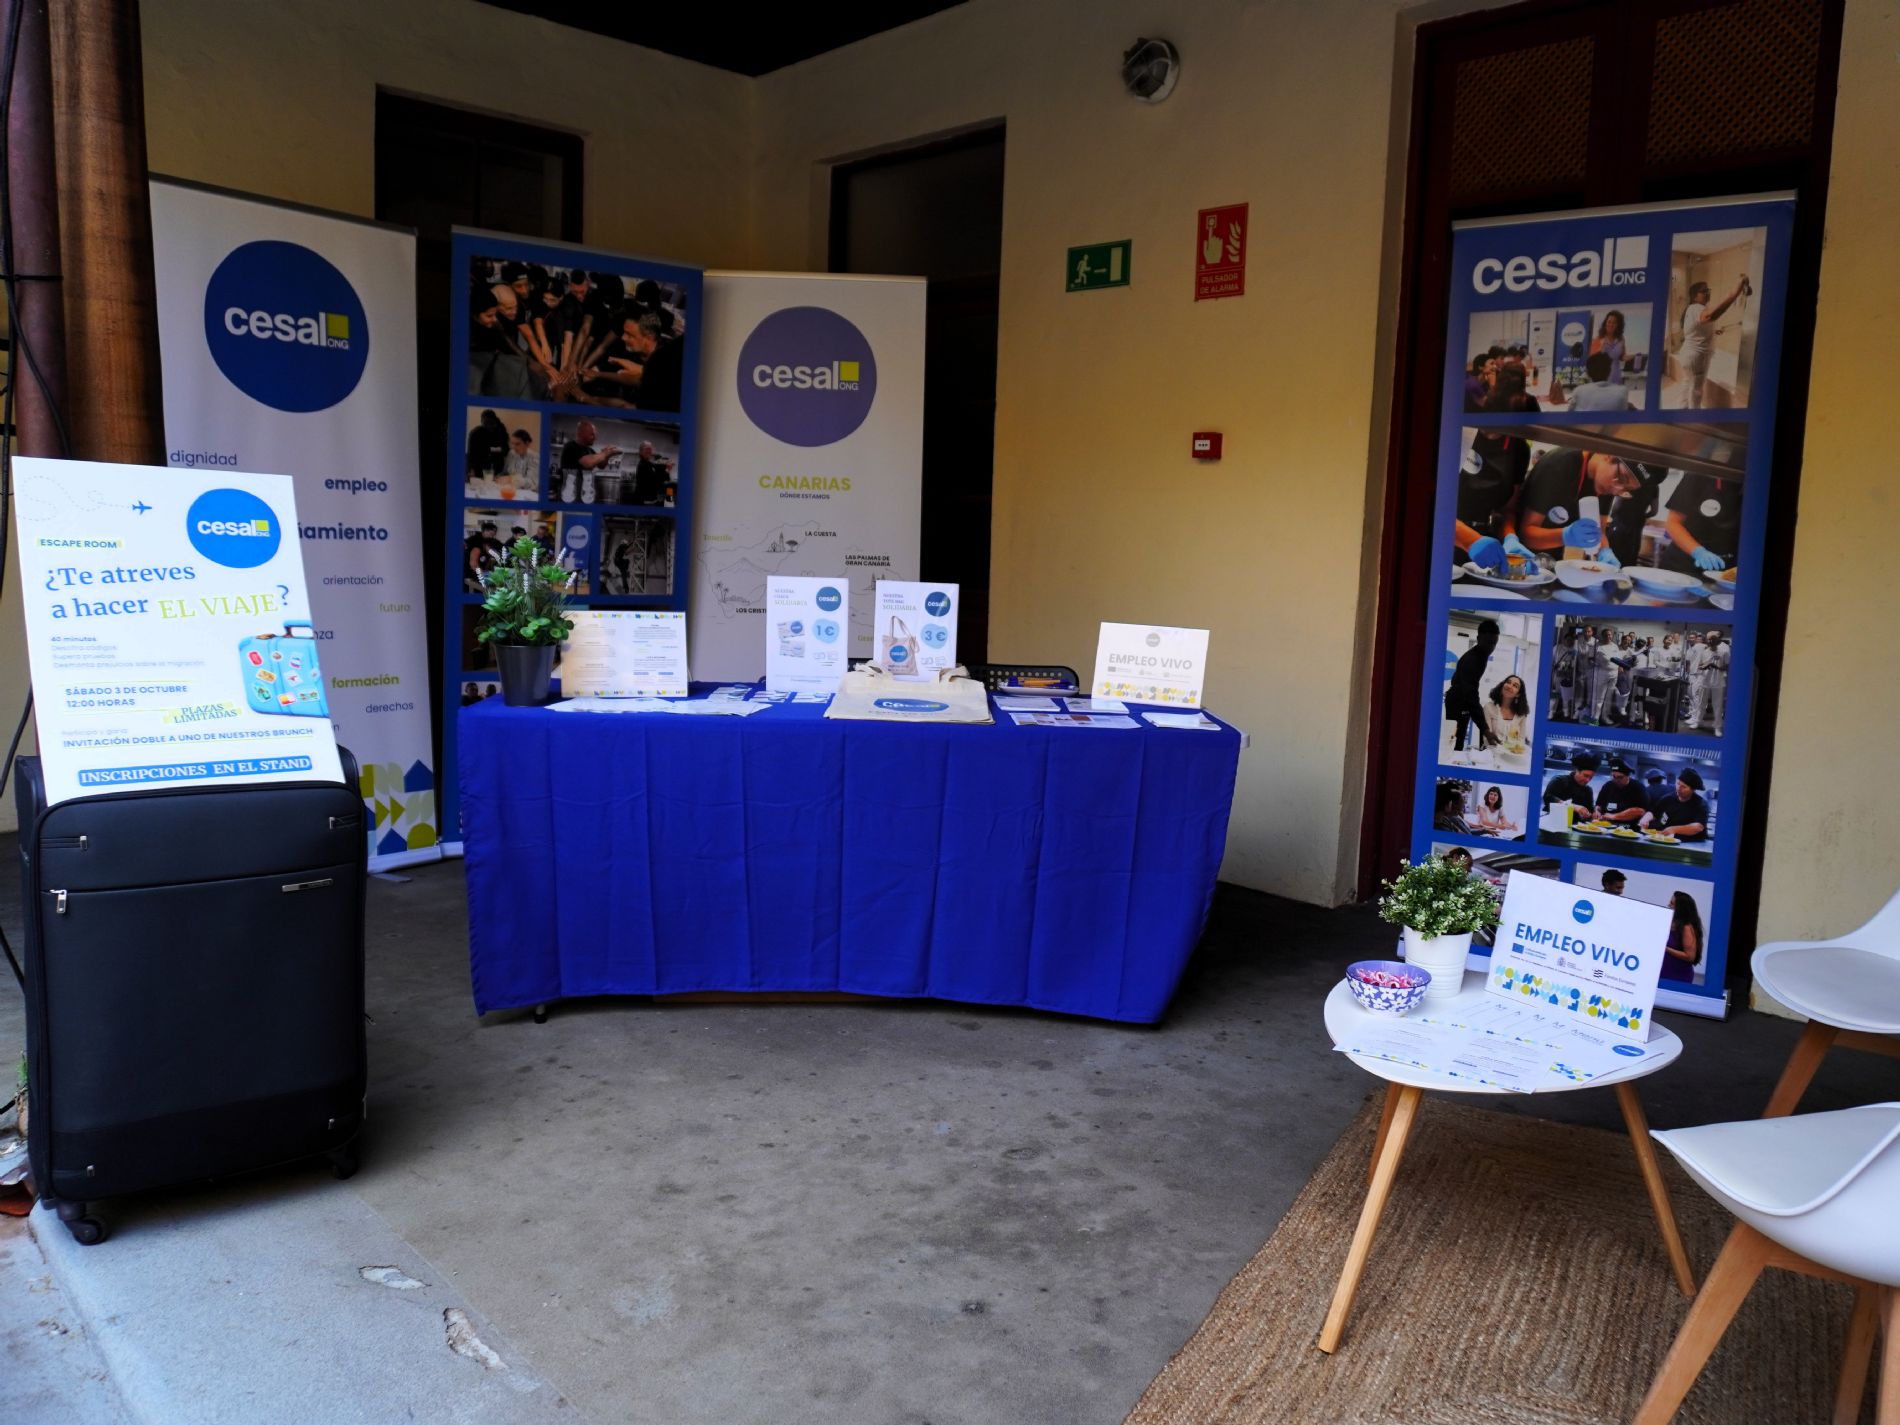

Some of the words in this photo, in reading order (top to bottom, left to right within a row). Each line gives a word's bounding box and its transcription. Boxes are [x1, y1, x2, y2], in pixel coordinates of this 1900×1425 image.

[1472, 238, 1614, 294] cesal
[1612, 270, 1646, 287] ONG
[1201, 272, 1239, 283] PULSADOR
[1200, 286, 1210, 294] DE
[1211, 283, 1240, 293] ALARMA
[224, 306, 327, 347] cesal
[327, 338, 349, 350] ONG
[753, 361, 838, 390] cesal
[839, 382, 860, 391] ONG
[170, 450, 238, 467] dignidad
[324, 477, 388, 495] empleo
[758, 474, 852, 491] CANARIAS
[801, 492, 831, 500] ESTAMOS
[197, 519, 256, 537] cesal
[40, 538, 82, 548] ESCAPE
[84, 540, 118, 549] ROOM
[45, 566, 94, 591] ¿Te
[101, 565, 196, 585] atreves
[322, 575, 384, 586] orientación
[51, 603, 66, 619] a
[74, 597, 149, 618] hacer
[158, 599, 196, 620] EL
[379, 602, 411, 613] futuro
[816, 625, 821, 636] 1
[824, 626, 835, 637] €
[924, 630, 932, 641] 3
[935, 631, 946, 641] €
[1109, 653, 1157, 667] EMPLEO
[1161, 657, 1193, 670] VIVO
[332, 674, 400, 688] formación
[65, 686, 112, 696] SÁBADO
[123, 686, 137, 694] DE
[139, 685, 188, 693] OCTUBRE
[66, 700, 95, 708] 12:00
[97, 698, 136, 706] HORAS
[182, 703, 224, 715] PLAZAS
[365, 701, 414, 714] derechos
[174, 709, 238, 724] LIMITADAS
[63, 736, 130, 747] INVITACIÓN
[132, 735, 166, 744] DOBLE
[168, 735, 176, 743] A
[178, 733, 202, 742] UNO
[204, 732, 217, 740] DE
[219, 730, 270, 740] NUESTROS
[272, 728, 313, 737] BRUNCH
[80, 765, 207, 783] INSCRIPCIONES
[213, 763, 236, 775] EN
[238, 761, 257, 773] EL
[260, 758, 311, 772] STAND
[1515, 922, 1586, 956] EMPLEO
[1591, 942, 1640, 971] VIVO
